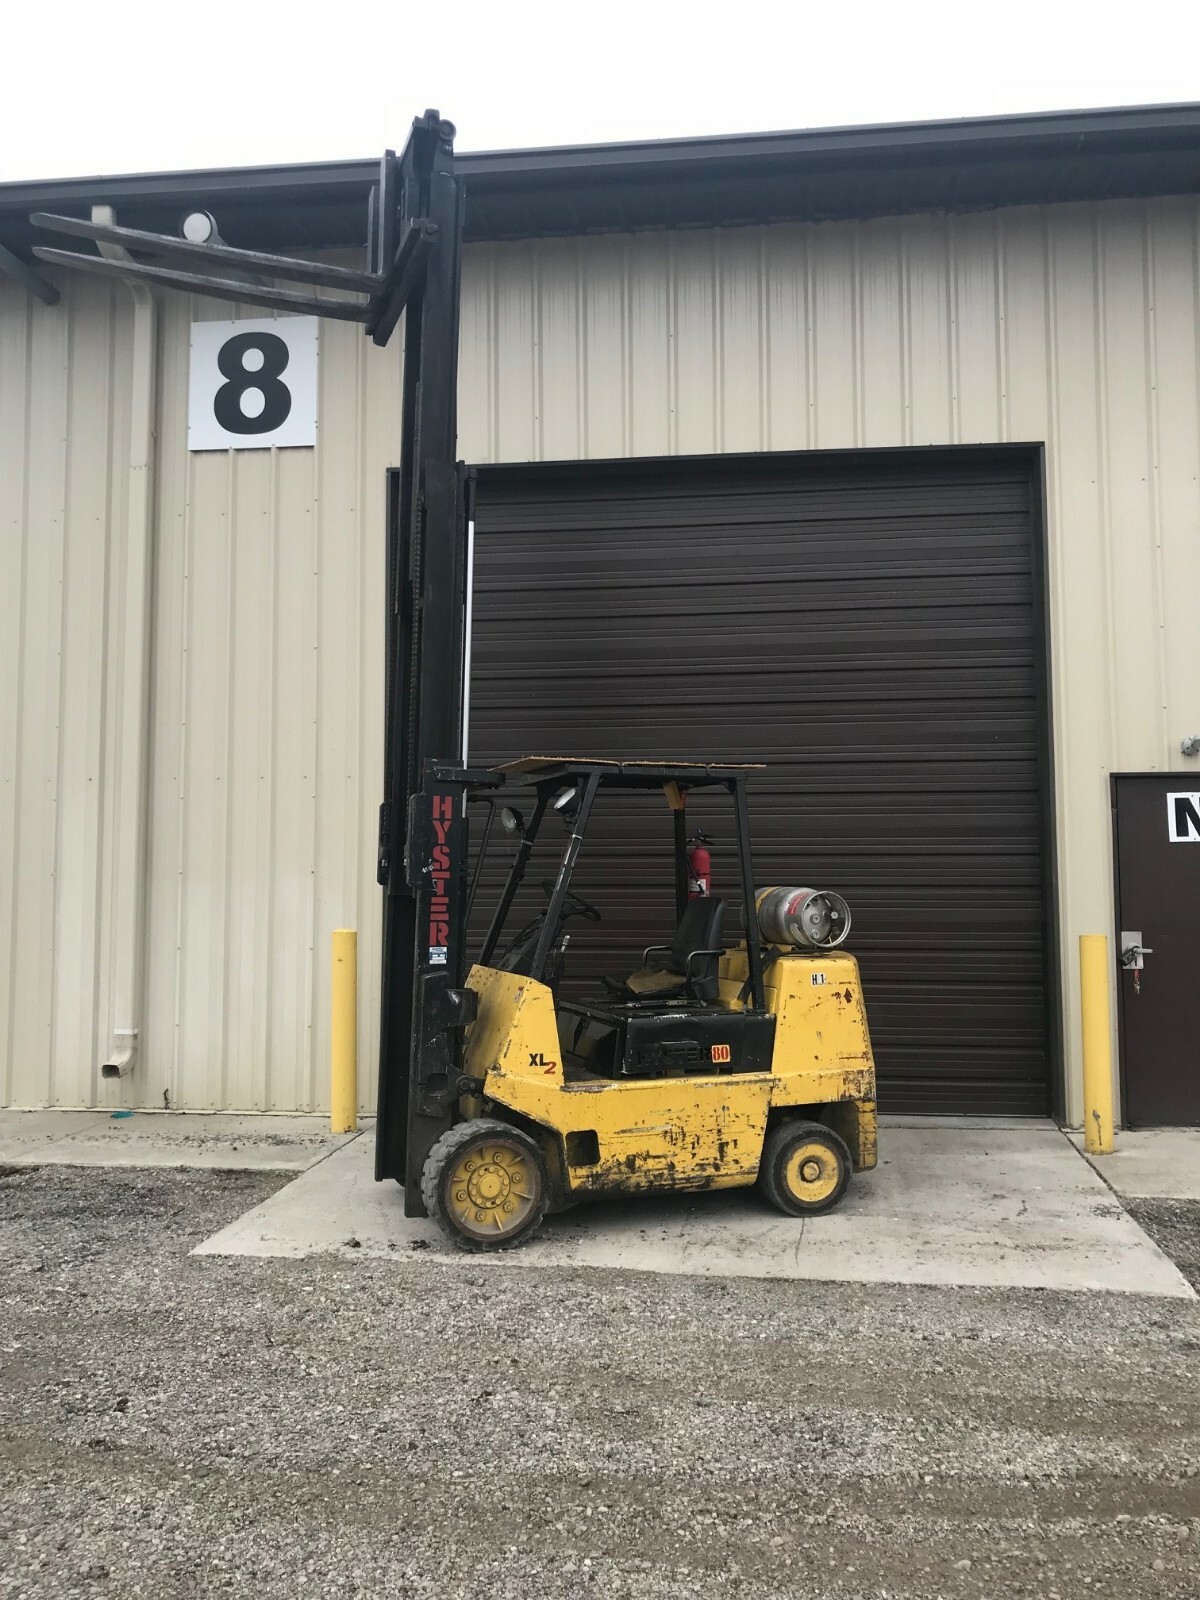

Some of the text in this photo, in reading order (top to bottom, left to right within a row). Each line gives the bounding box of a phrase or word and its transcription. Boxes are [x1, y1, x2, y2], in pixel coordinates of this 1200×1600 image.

[213, 331, 291, 435] 8
[428, 795, 453, 946] HYSTER
[712, 1046, 729, 1061] 80
